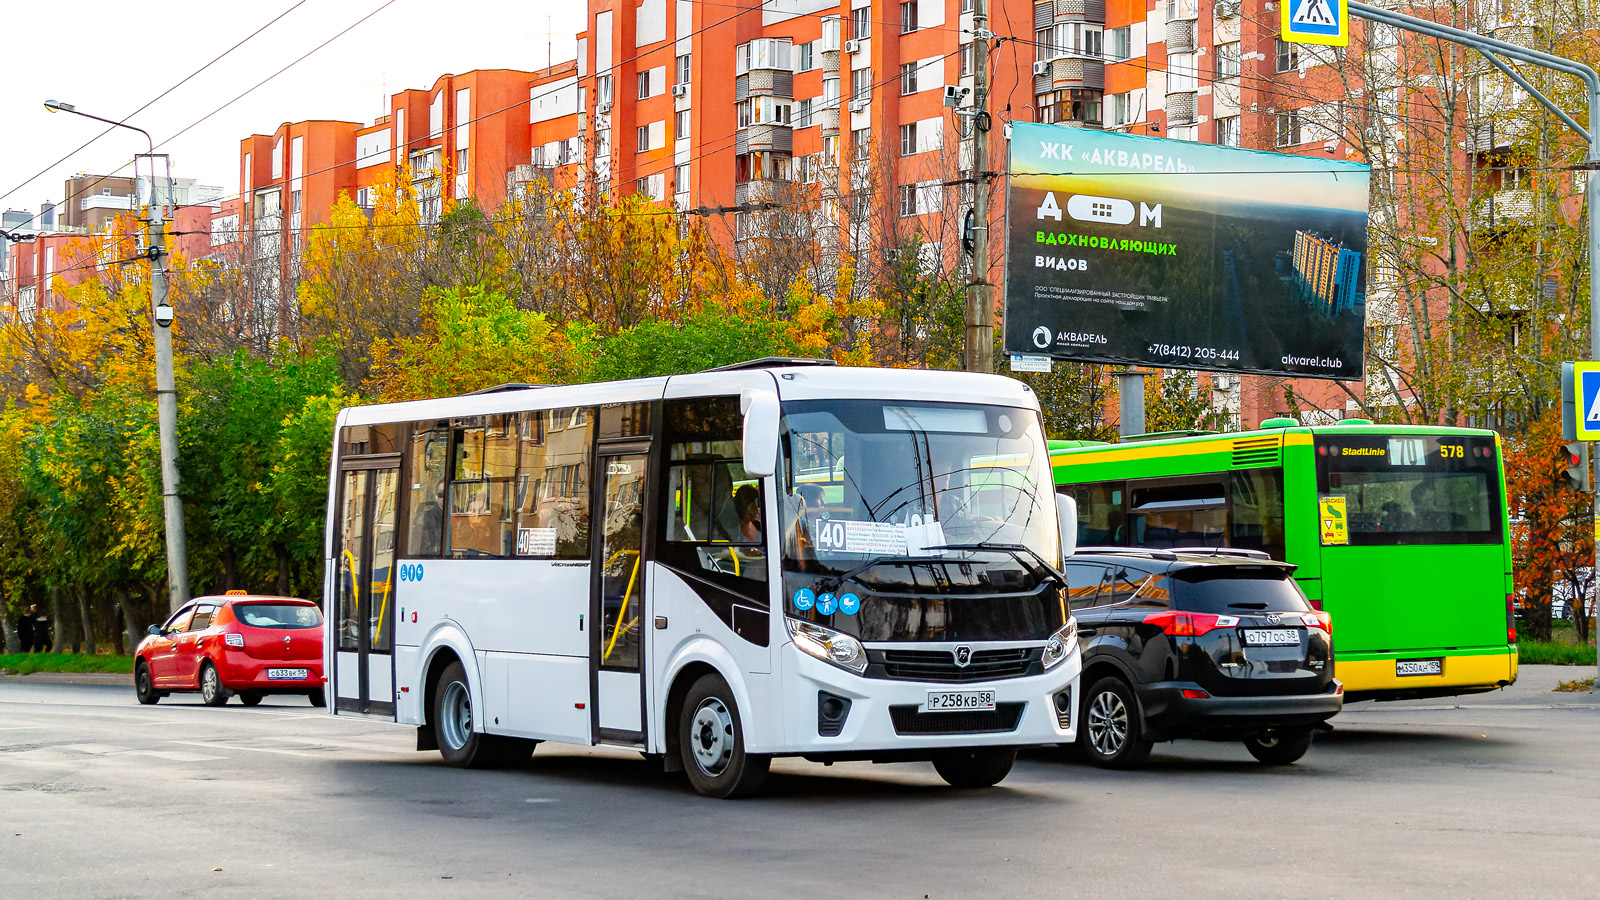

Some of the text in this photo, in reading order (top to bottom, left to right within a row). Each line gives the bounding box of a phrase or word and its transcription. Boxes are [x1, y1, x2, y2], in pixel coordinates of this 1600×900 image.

[1040, 141, 1196, 173] ЖК «АКВАРЕЛЬ»
[1036, 230, 1177, 256] ВДОХНОВЛЯЮЩИХ
[1035, 256, 1088, 272] ВИДОВ
[1056, 332, 1108, 344] АКВАРЕЛЬ
[1148, 344, 1240, 360] +7(8412) 205-444
[1282, 354, 1342, 368] akvarel.club
[1342, 448, 1386, 456] StadtLinie
[1396, 439, 1418, 465] 70
[1440, 445, 1464, 458] 578
[519, 531, 528, 552] 40
[820, 522, 844, 548] 40
